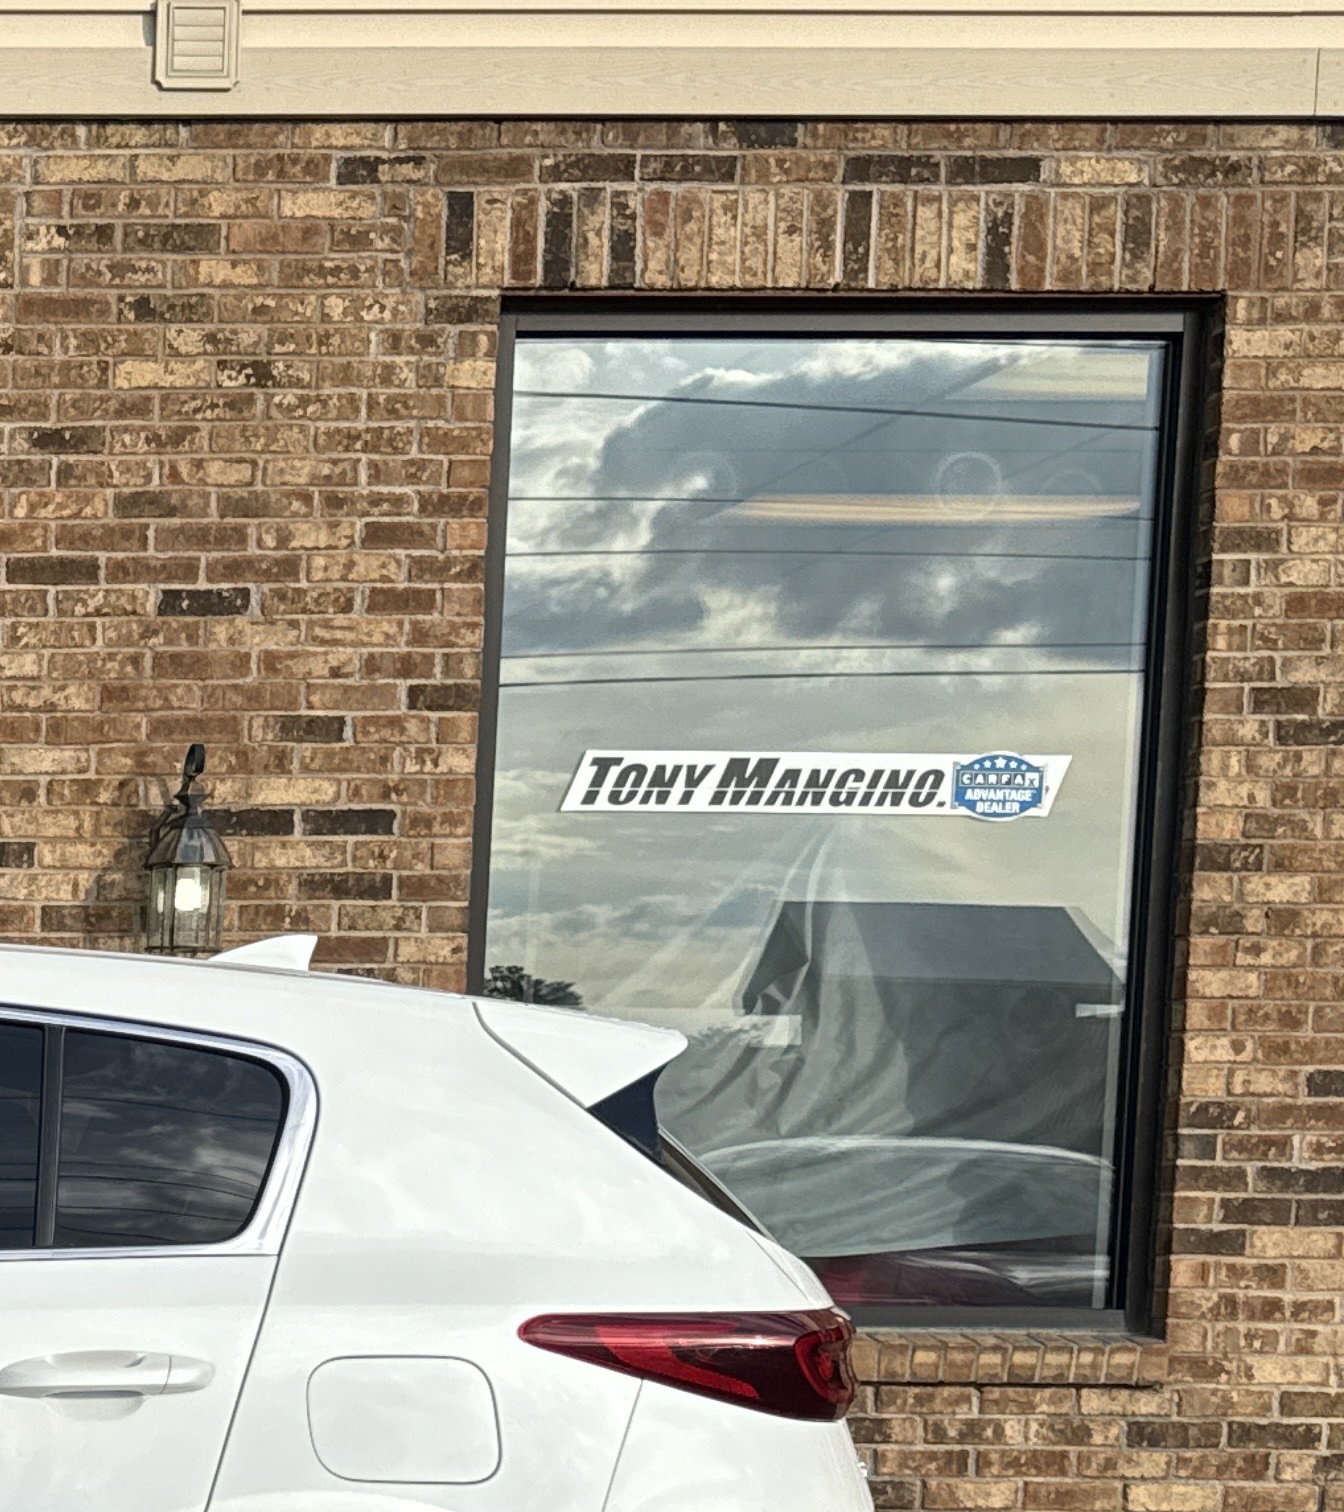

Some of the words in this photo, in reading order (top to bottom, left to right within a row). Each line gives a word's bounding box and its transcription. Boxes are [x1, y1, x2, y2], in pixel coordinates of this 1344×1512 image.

[581, 757, 715, 806] TONY
[961, 773, 1039, 787] CARFAX
[964, 788, 1033, 802] ADVANTAGE
[976, 801, 1020, 814] DEALER
